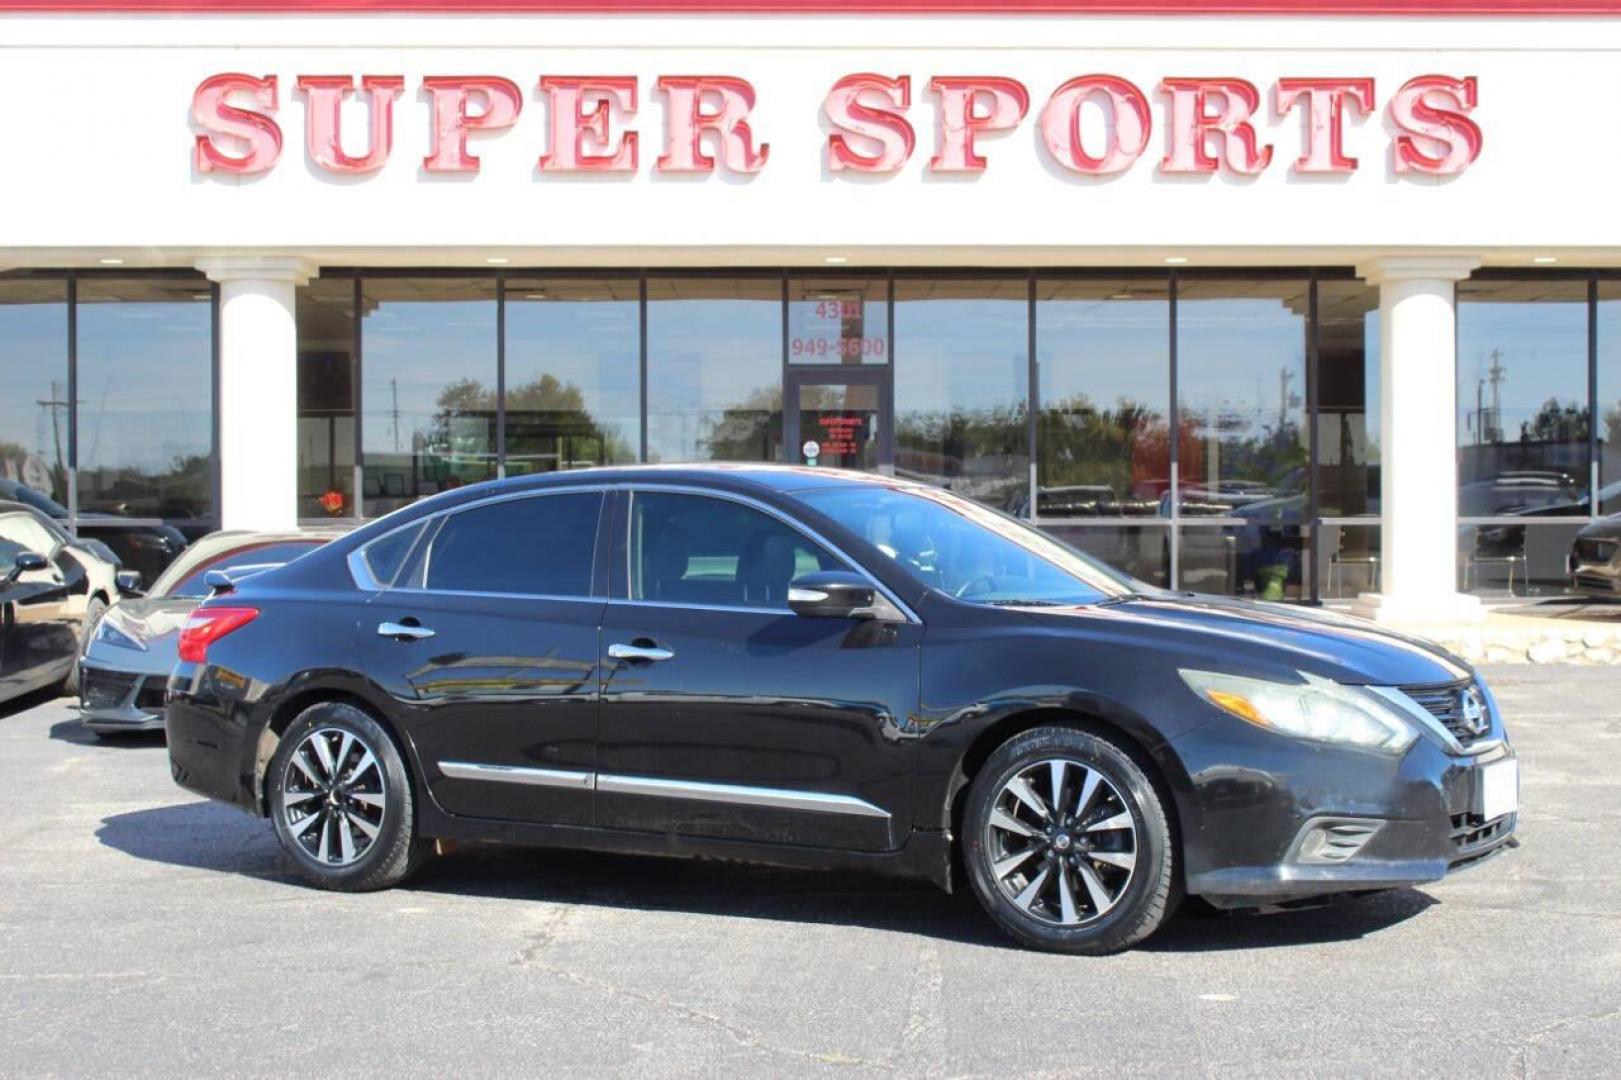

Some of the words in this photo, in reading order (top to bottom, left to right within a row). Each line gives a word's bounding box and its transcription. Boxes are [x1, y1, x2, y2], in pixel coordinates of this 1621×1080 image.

[193, 72, 770, 174] SUPER
[825, 72, 1483, 175] SPORTS
[792, 338, 884, 356] 949-5600
